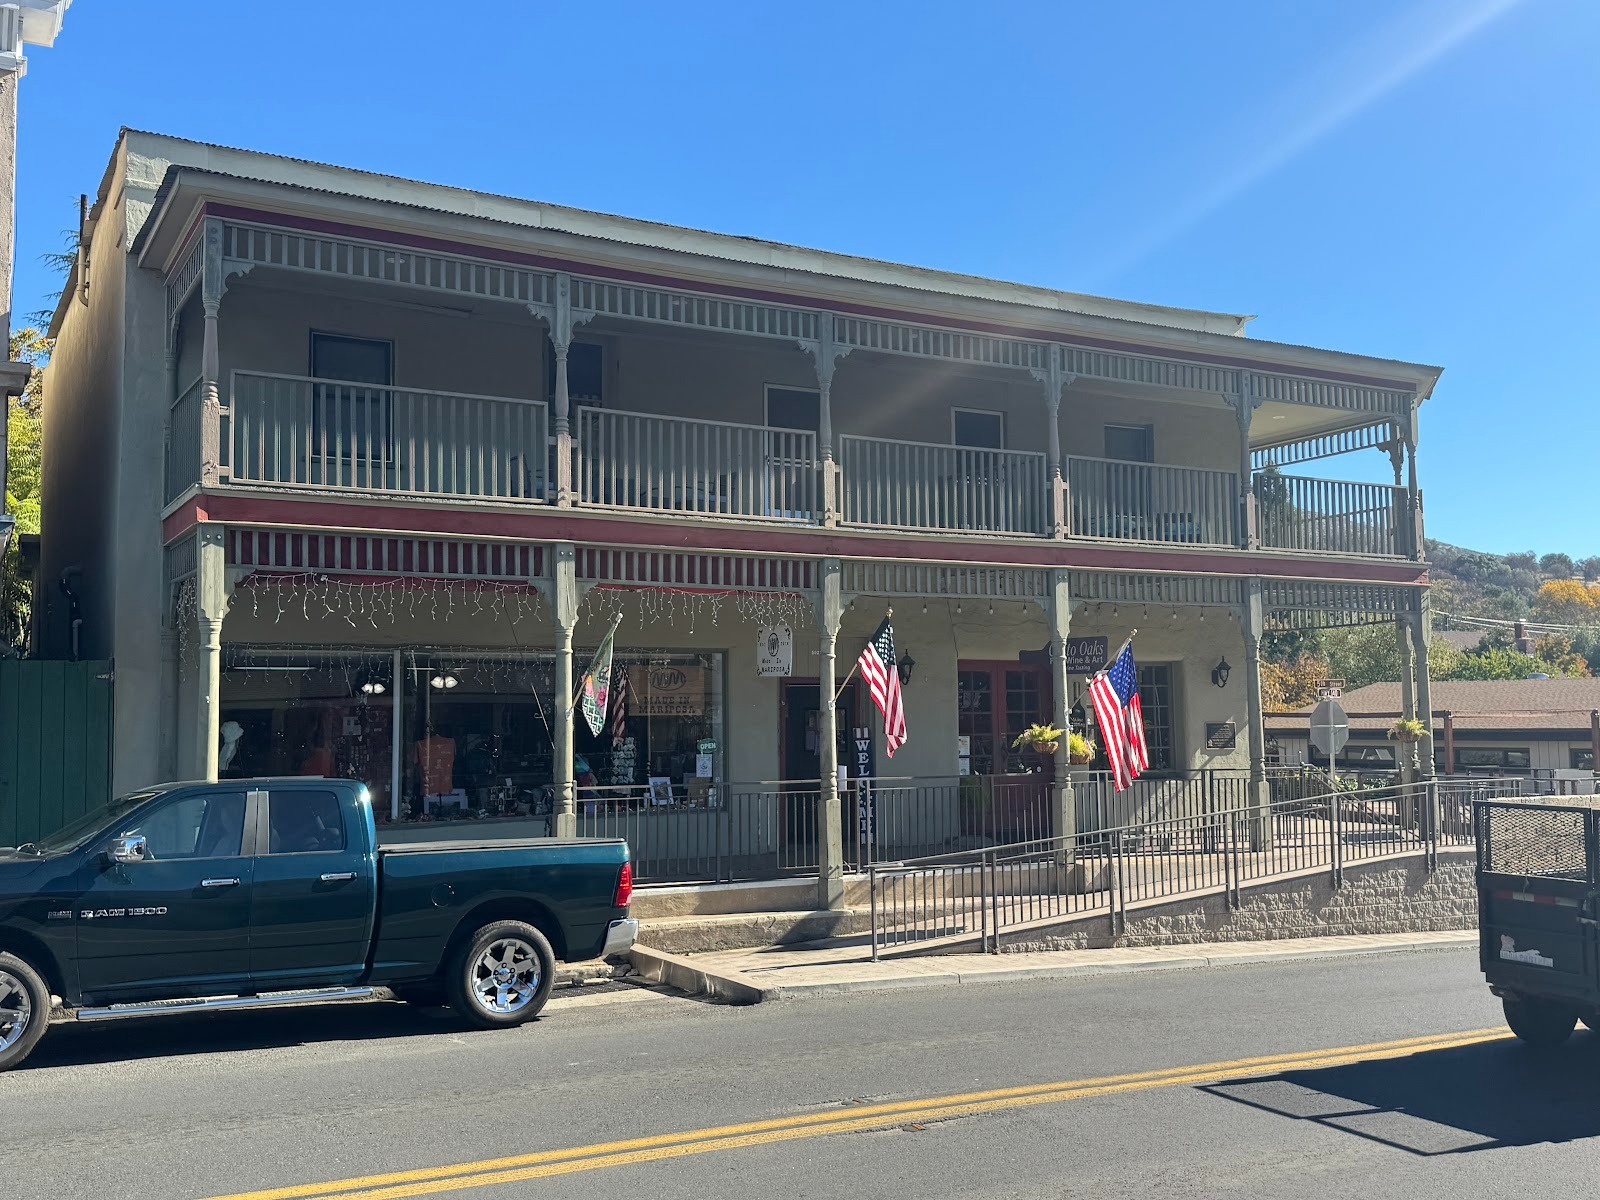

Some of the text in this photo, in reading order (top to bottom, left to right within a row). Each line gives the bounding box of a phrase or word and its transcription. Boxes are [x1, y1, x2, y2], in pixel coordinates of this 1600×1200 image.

[1080, 640, 1104, 656] Oaks
[1091, 656, 1104, 664] Art
[643, 696, 691, 705] MADE IN
[639, 705, 696, 714] MARIPOSA
[700, 742, 717, 750] OPEN
[80, 908, 125, 918] RAM
[128, 906, 168, 916] 1500
